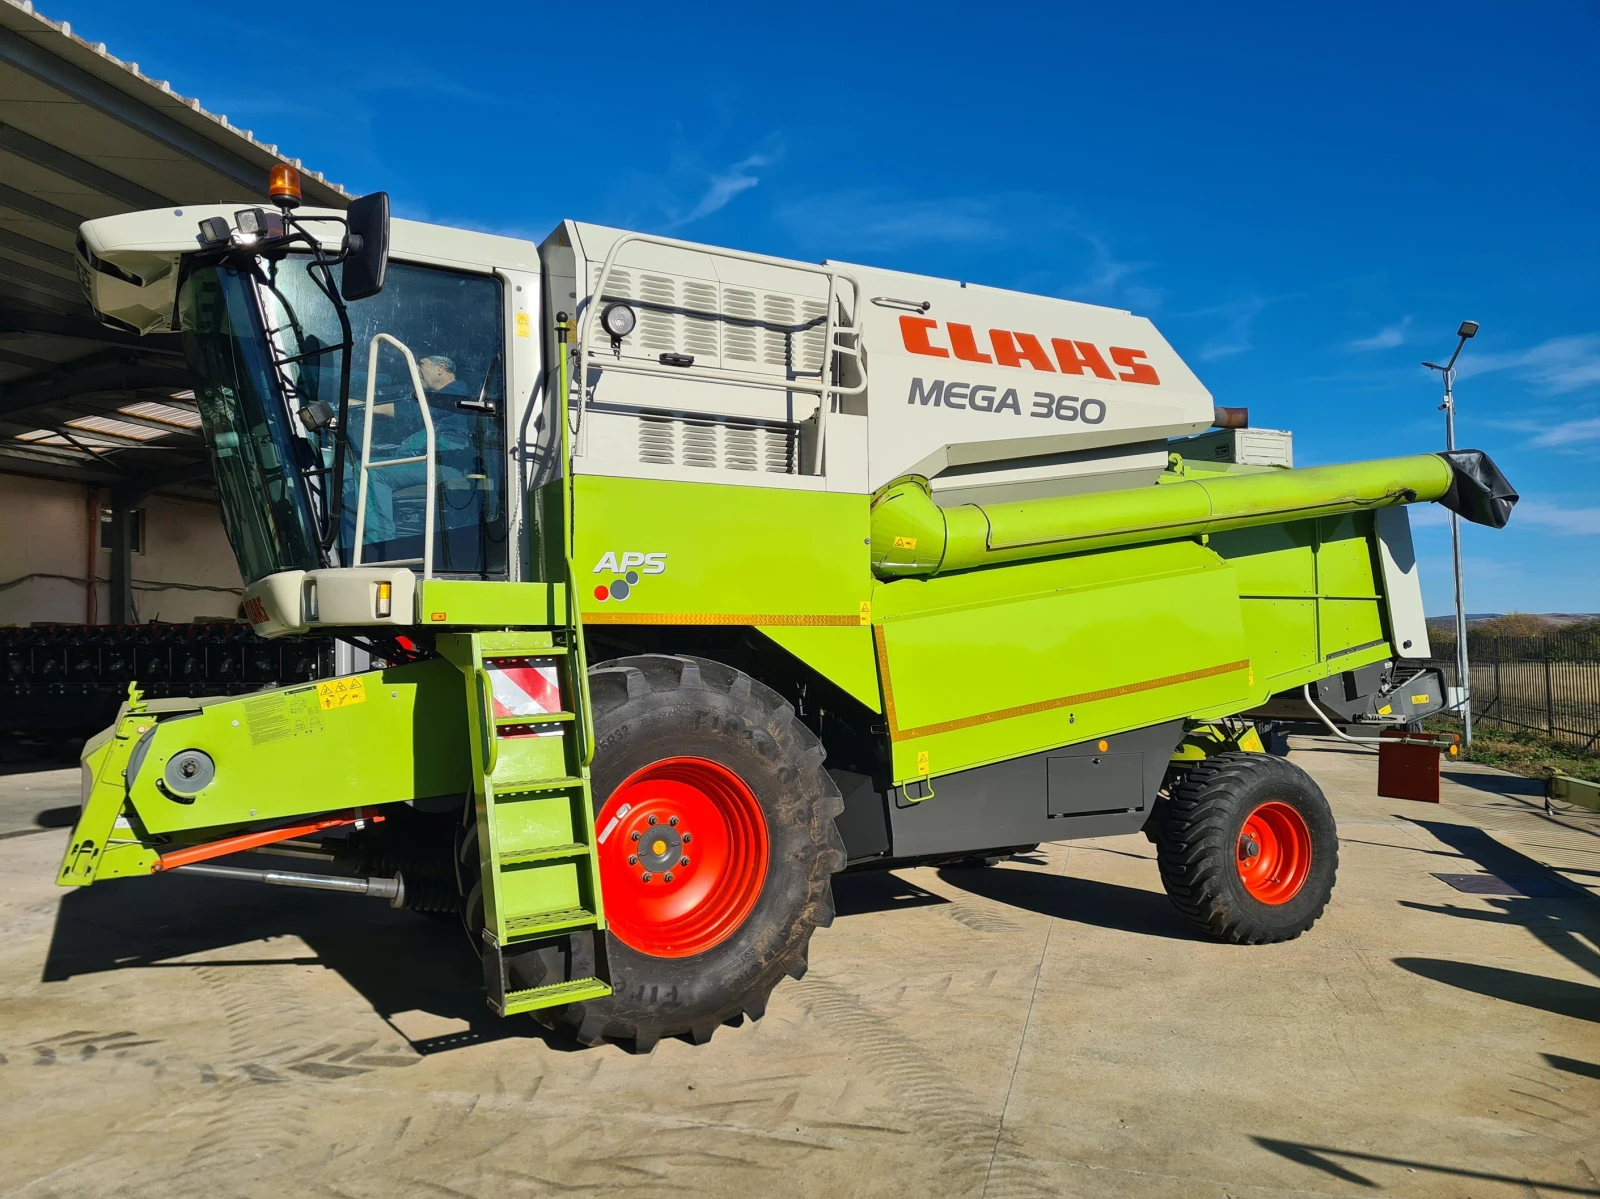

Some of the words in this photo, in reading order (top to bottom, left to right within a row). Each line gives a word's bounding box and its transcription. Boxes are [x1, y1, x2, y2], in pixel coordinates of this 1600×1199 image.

[899, 315, 1161, 386] CLAAS
[907, 377, 1022, 415] MEGA
[1030, 391, 1107, 425] 360
[592, 551, 668, 575] APS
